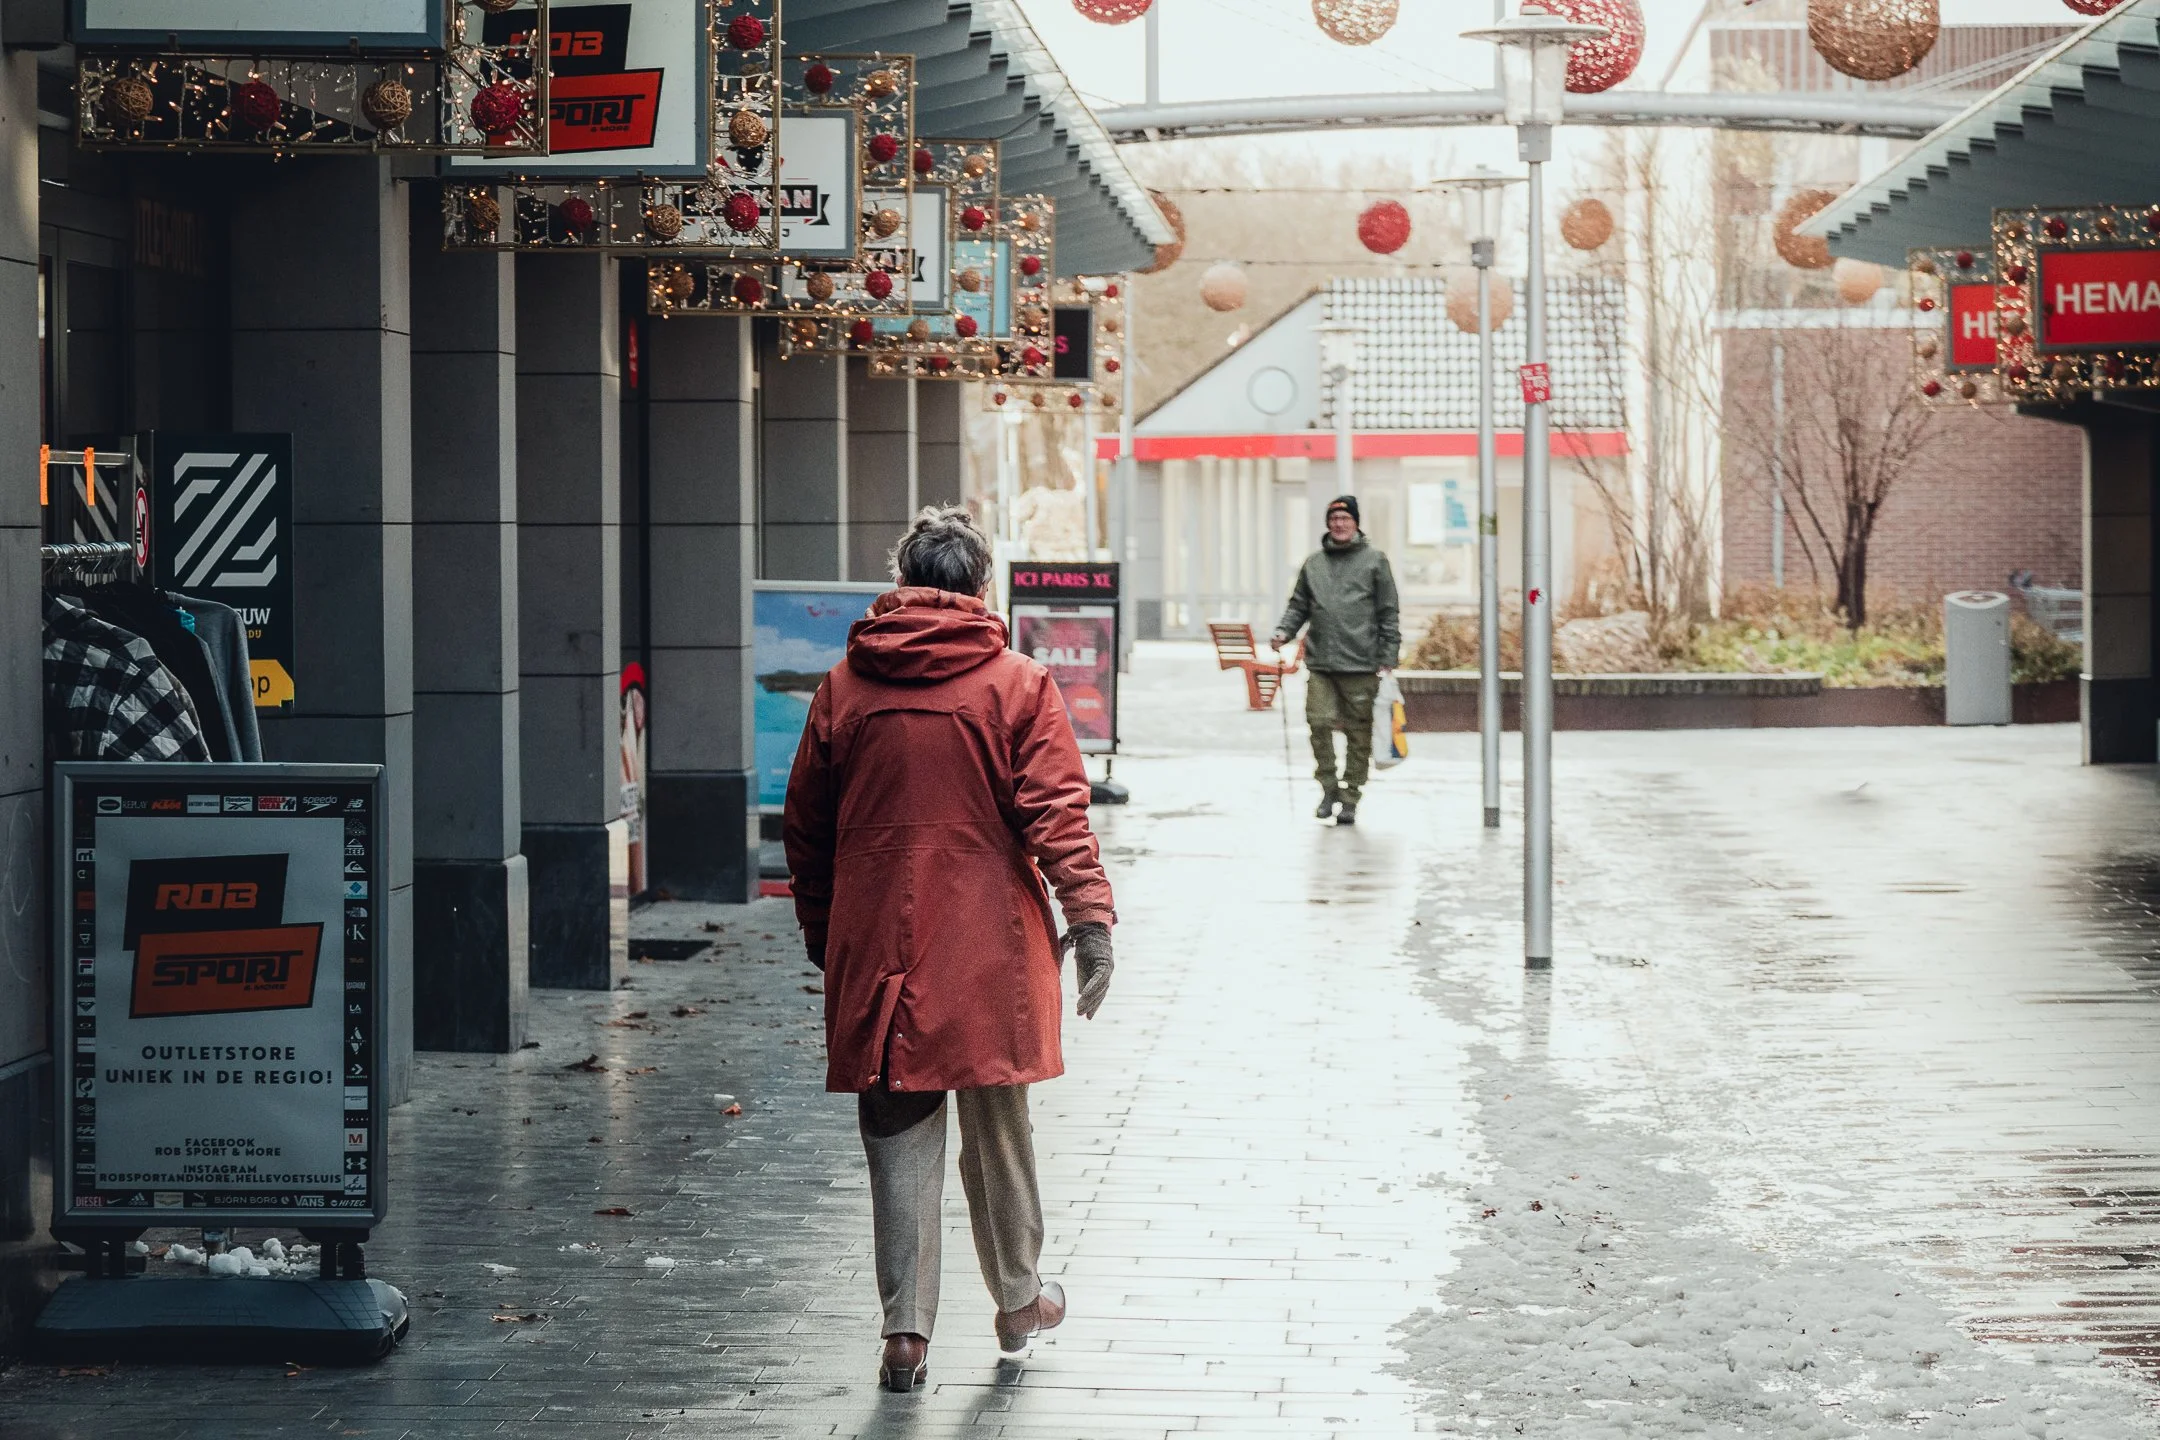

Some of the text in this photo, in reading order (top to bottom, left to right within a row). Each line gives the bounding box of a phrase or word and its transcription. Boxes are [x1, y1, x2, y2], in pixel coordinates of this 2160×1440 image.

[549, 94, 645, 126] PORT
[2056, 281, 2160, 314] HEMA
[1014, 572, 1111, 588] ICI PARIS XL
[1033, 647, 1097, 666] SALE
[123, 800, 148, 809] REPLAY
[303, 796, 337, 805] speedo
[155, 882, 258, 910] ROB
[152, 950, 304, 986] SPORT
[141, 1046, 296, 1061] OUTLETSTORE
[106, 1069, 333, 1084] UNIEK IN DE REGIO!
[185, 1138, 256, 1147] FACEBOOK
[155, 1147, 281, 1156] ROB SPORT & MORE
[183, 1165, 258, 1174] INSTAGRAM
[99, 1173, 342, 1184] ROBSPORTANDMORE.HELLEVOETSLUIS
[76, 1196, 104, 1207] DIESEL
[214, 1195, 278, 1204] BJÖRN BORG
[294, 1195, 325, 1207] VANS
